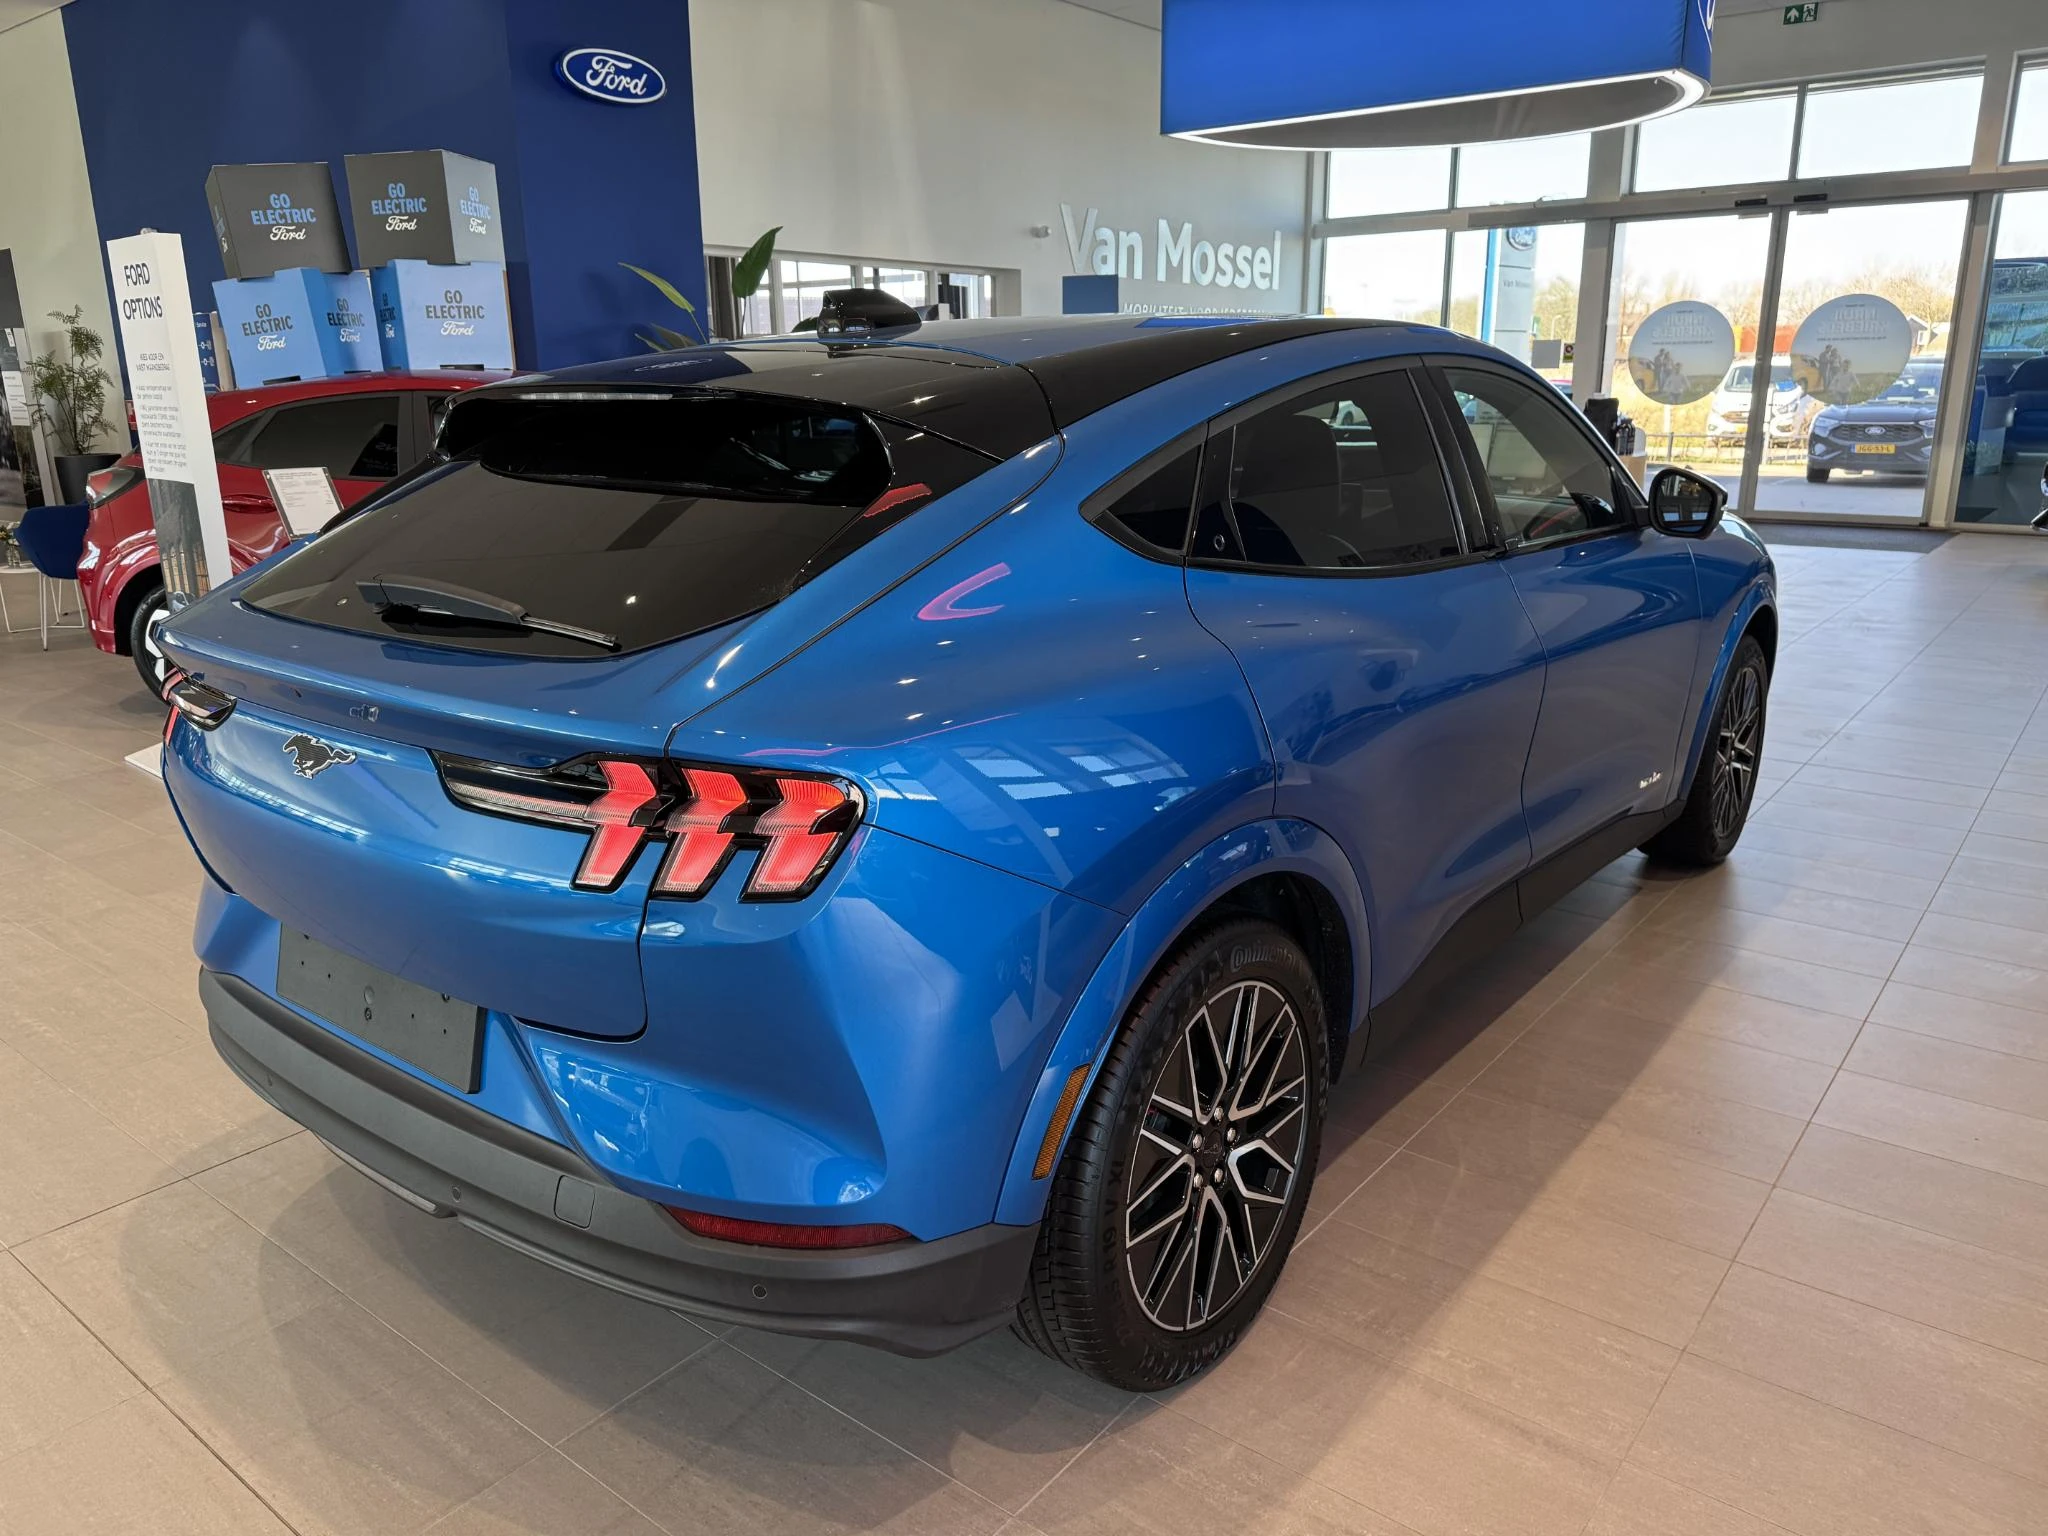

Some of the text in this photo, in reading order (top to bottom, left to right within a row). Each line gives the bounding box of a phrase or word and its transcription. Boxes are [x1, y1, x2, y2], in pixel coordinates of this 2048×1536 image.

[586, 55, 648, 95] Ford
[388, 183, 406, 198] GO
[468, 187, 479, 201] GO
[269, 193, 291, 208] GO
[371, 198, 427, 215] ELECTRIC
[251, 208, 317, 225] ELECTRIC
[460, 200, 491, 219] ELECTRIC
[385, 215, 417, 231] Ford
[469, 217, 487, 234] Ford
[269, 225, 306, 240] Ford
[1060, 203, 1282, 290] Van Mossel
[124, 263, 150, 286] FORD
[336, 298, 349, 312] GO
[444, 290, 462, 304] GO
[123, 296, 163, 320] OPTIONS
[255, 304, 272, 319] GO
[425, 305, 485, 320] ELECTRIC
[242, 315, 293, 336] ELECTRIC
[327, 312, 365, 327] ELECTRIC
[340, 328, 360, 342] Ford
[440, 320, 475, 336] Ford
[257, 334, 287, 351] Ford
[1230, 939, 1297, 973] Continental
